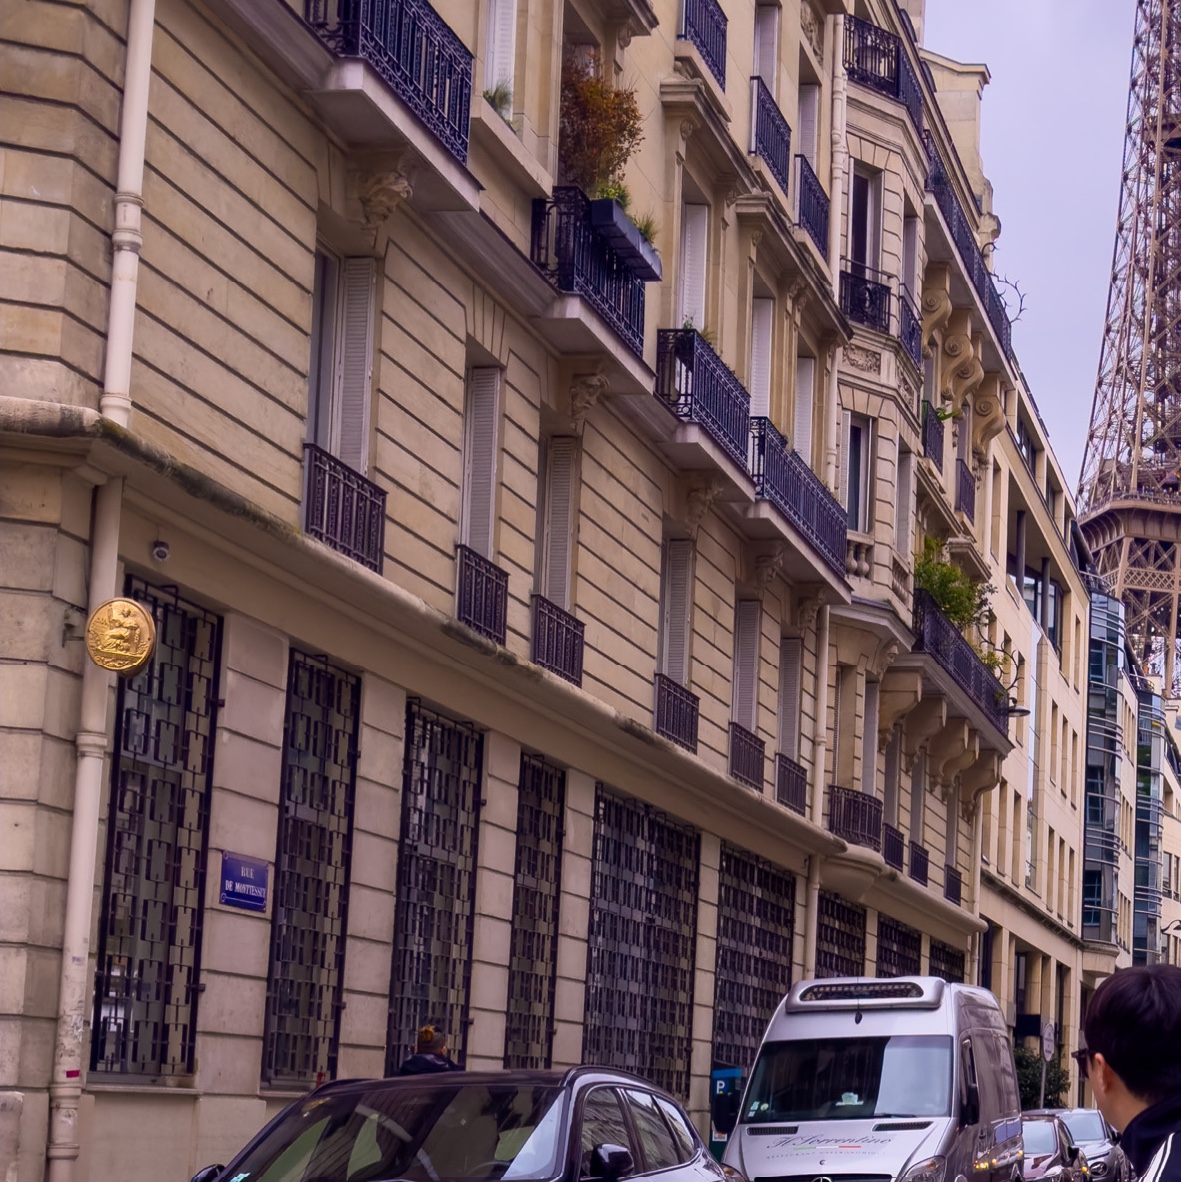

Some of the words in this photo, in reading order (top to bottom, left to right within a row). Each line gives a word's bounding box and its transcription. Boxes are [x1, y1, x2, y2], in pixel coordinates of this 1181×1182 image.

[241, 866, 254, 879] RUE
[225, 879, 234, 892] DE
[716, 1080, 726, 1095] P
